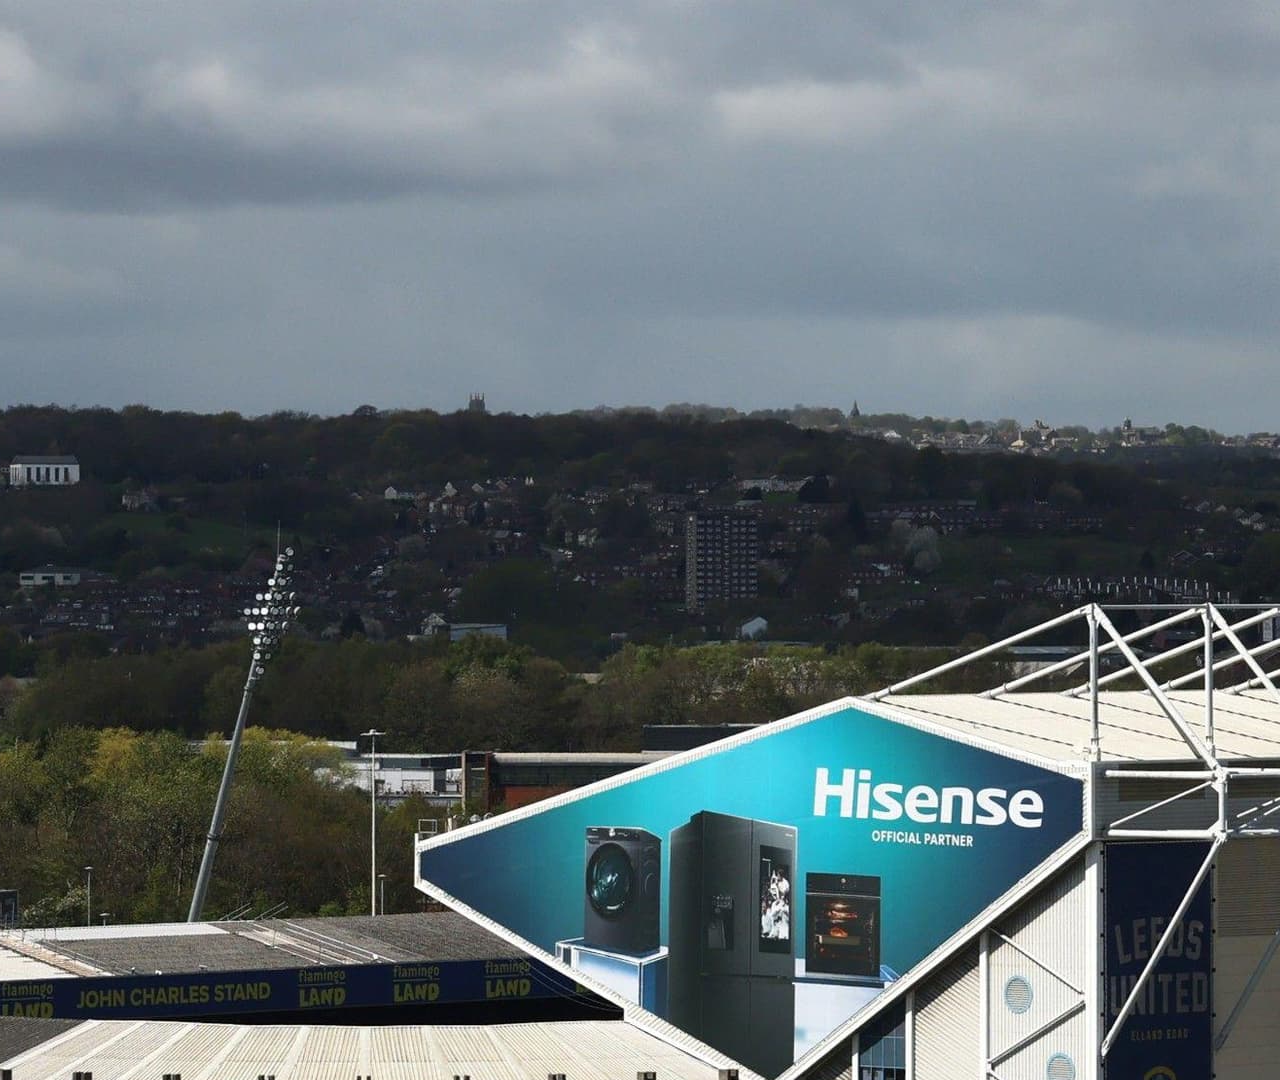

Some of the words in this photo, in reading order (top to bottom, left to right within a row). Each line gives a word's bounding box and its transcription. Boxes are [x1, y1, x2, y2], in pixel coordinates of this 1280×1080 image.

[813, 767, 1044, 828] Hisense
[871, 830, 921, 845] OFFICIAL
[924, 833, 974, 848] PARTNER
[1114, 916, 1204, 965] LEEDS
[299, 967, 346, 984] flamingo
[393, 963, 440, 980] flamingo
[484, 960, 531, 975] flamingo
[1, 982, 53, 999] flamingo
[76, 988, 125, 1009] JOHN
[130, 985, 210, 1006] CHARLES
[214, 982, 271, 1002] STAND
[300, 987, 346, 1008] LAND
[394, 982, 440, 1003] LAND
[485, 978, 531, 998] LAND
[1110, 971, 1208, 1016] UNITED
